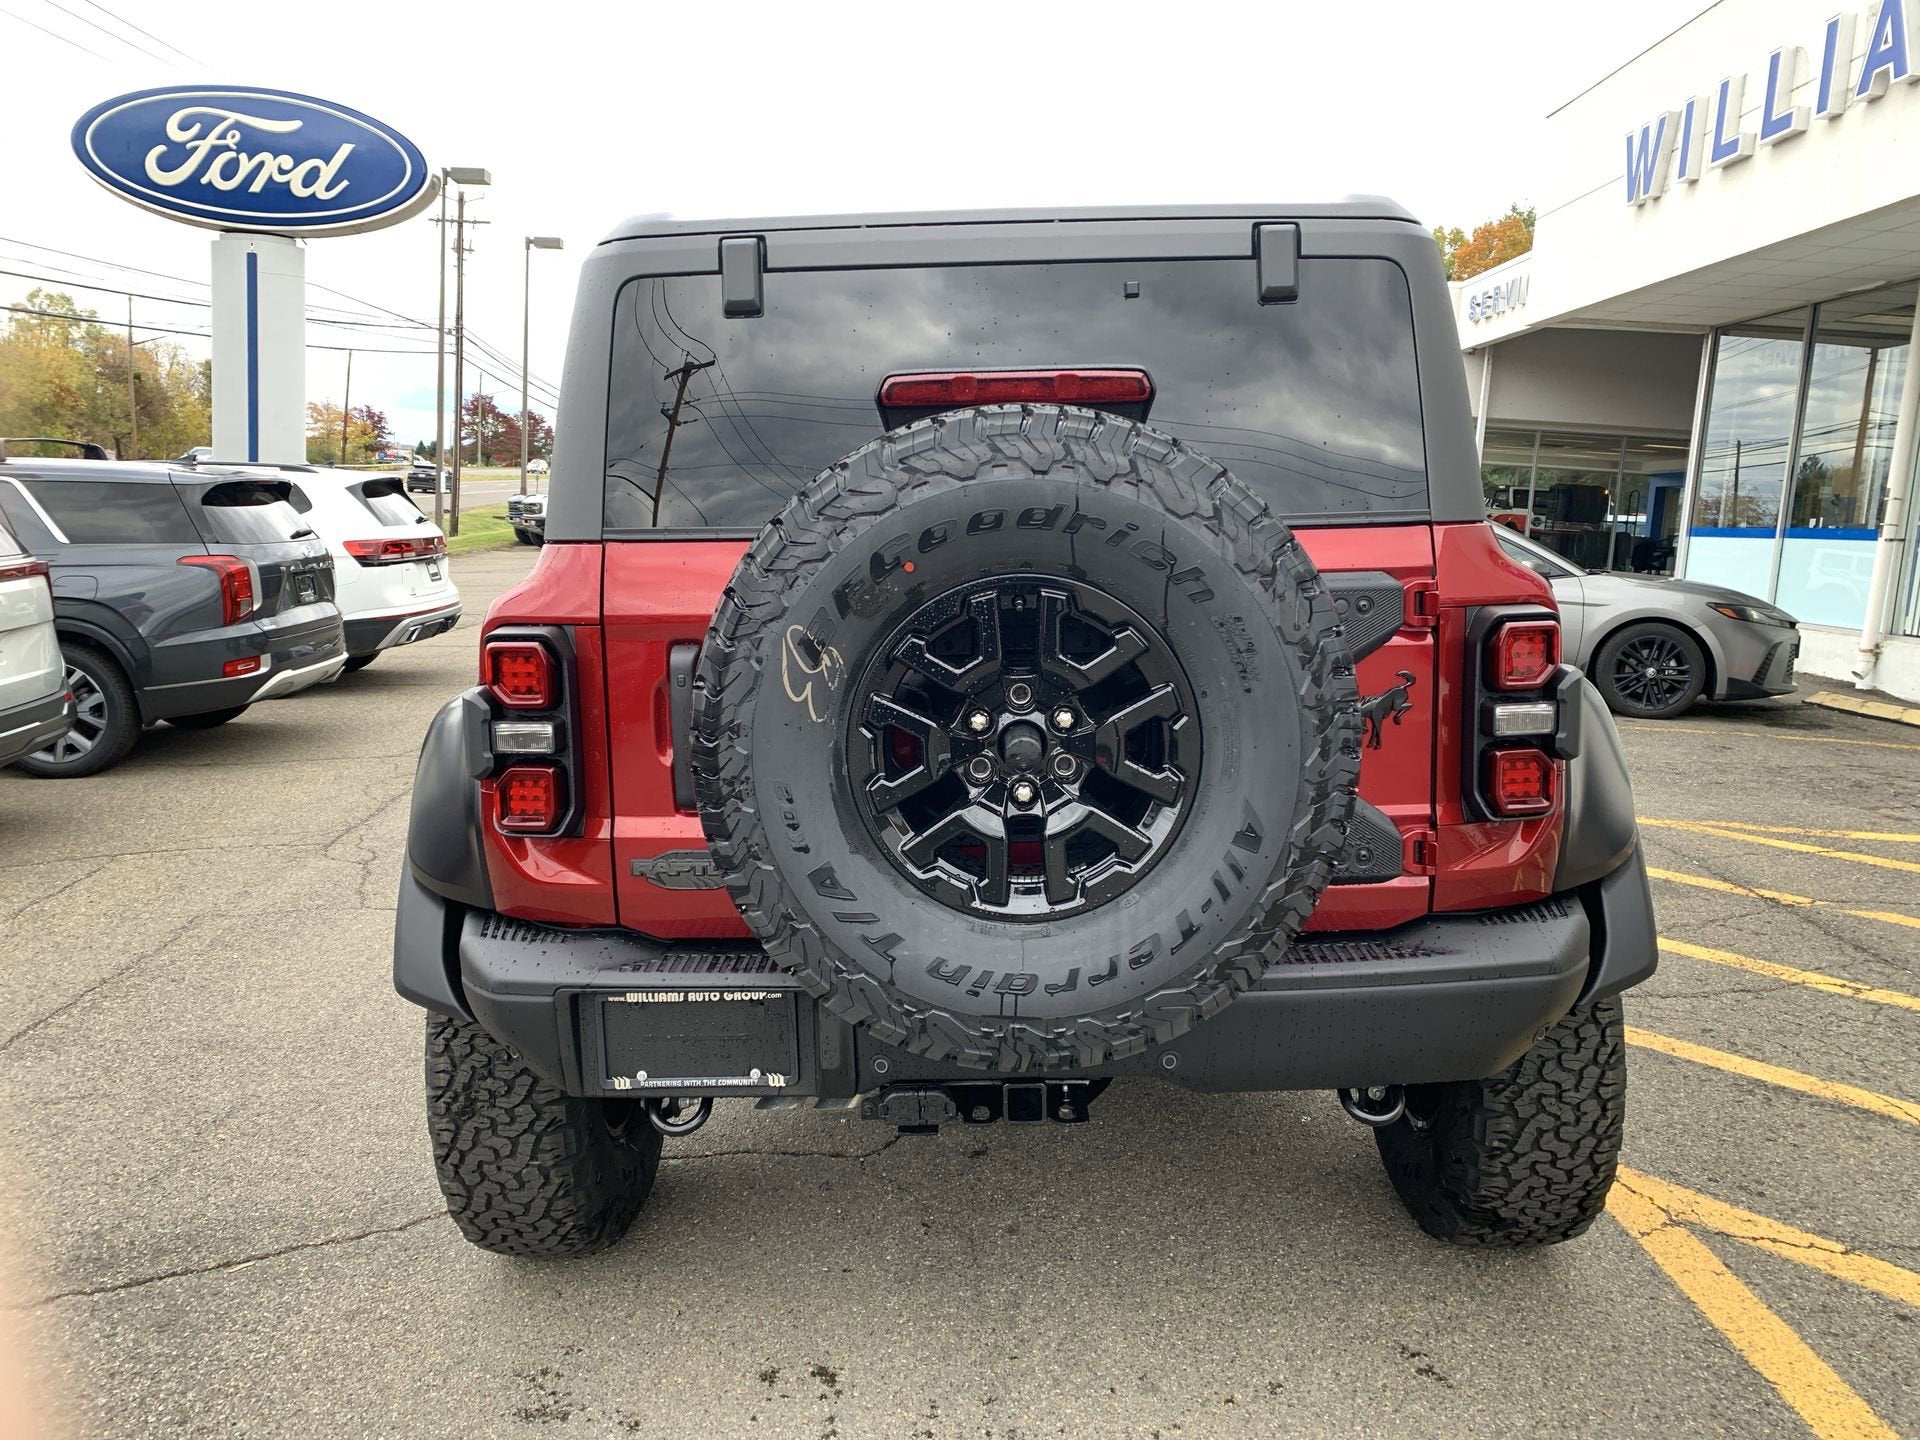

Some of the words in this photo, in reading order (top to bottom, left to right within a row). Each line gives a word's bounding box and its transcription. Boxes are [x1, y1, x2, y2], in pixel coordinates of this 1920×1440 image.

[145, 106, 356, 200] Ford
[1469, 274, 1530, 321] SERVI
[798, 503, 1215, 668] BFGoodrich
[807, 860, 905, 961] T/A
[924, 799, 1264, 996] All-Terrain
[688, 992, 720, 1002] AUTO
[640, 1080, 682, 1088] PARTNERING
[683, 1079, 701, 1087] WITH
[702, 1079, 716, 1087] THE
[717, 1078, 759, 1086] COMMUNITY
